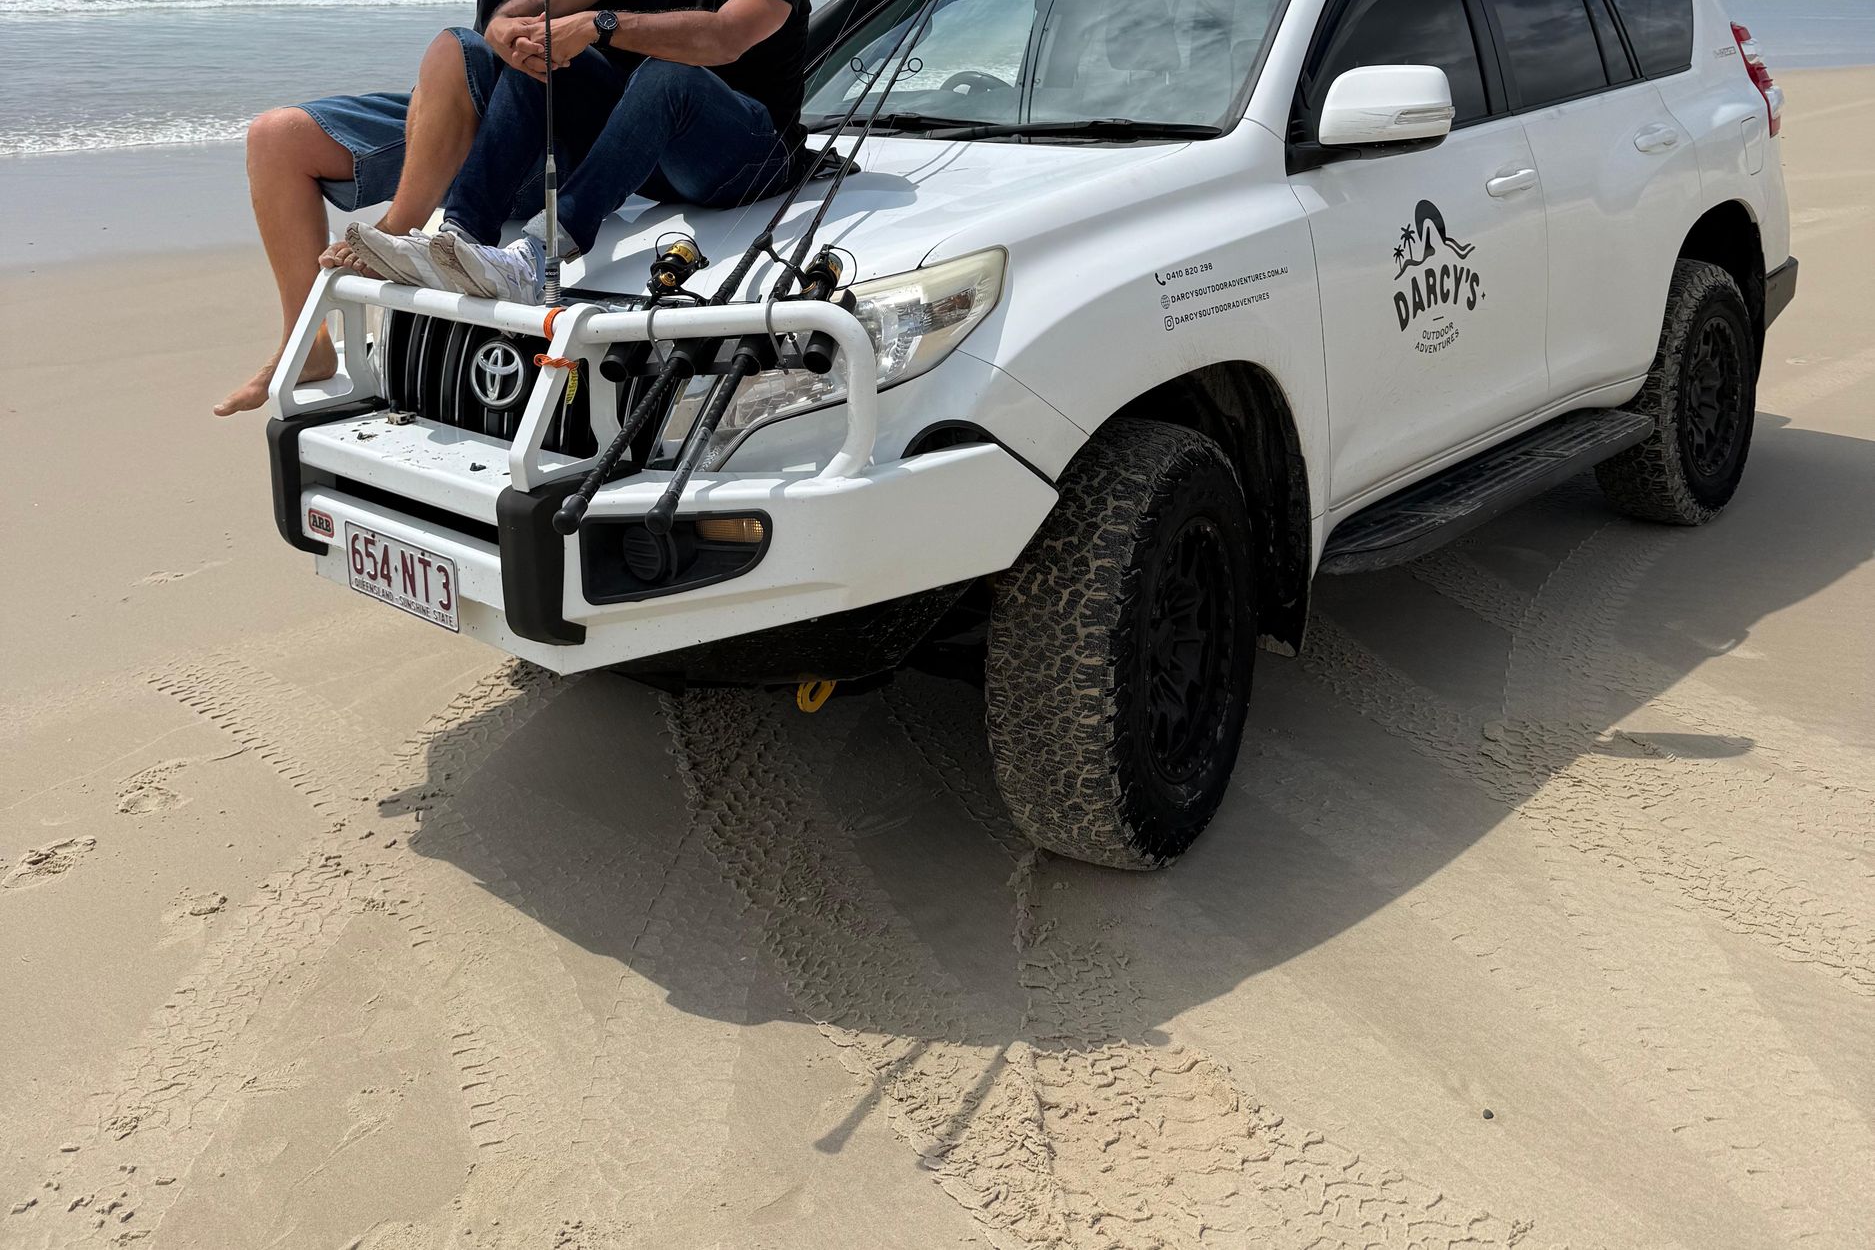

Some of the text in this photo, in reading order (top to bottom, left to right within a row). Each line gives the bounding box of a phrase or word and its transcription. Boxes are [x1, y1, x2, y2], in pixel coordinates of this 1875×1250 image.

[1165, 262, 1213, 281] 0410 820 298
[1170, 266, 1289, 304] DARCYSOUTDOORADVENTURES.COM.AU
[1174, 291, 1270, 325] DARCYSOUTDOORADVENTURES
[1393, 264, 1480, 332] DARCY'S
[1414, 328, 1460, 353] ADVENTURES
[1422, 321, 1454, 340] OUTDOOR
[311, 514, 332, 533] ARB
[354, 577, 394, 602] QUEENSLAND
[399, 596, 431, 617] SUNSHINE
[433, 609, 454, 628] STATE
